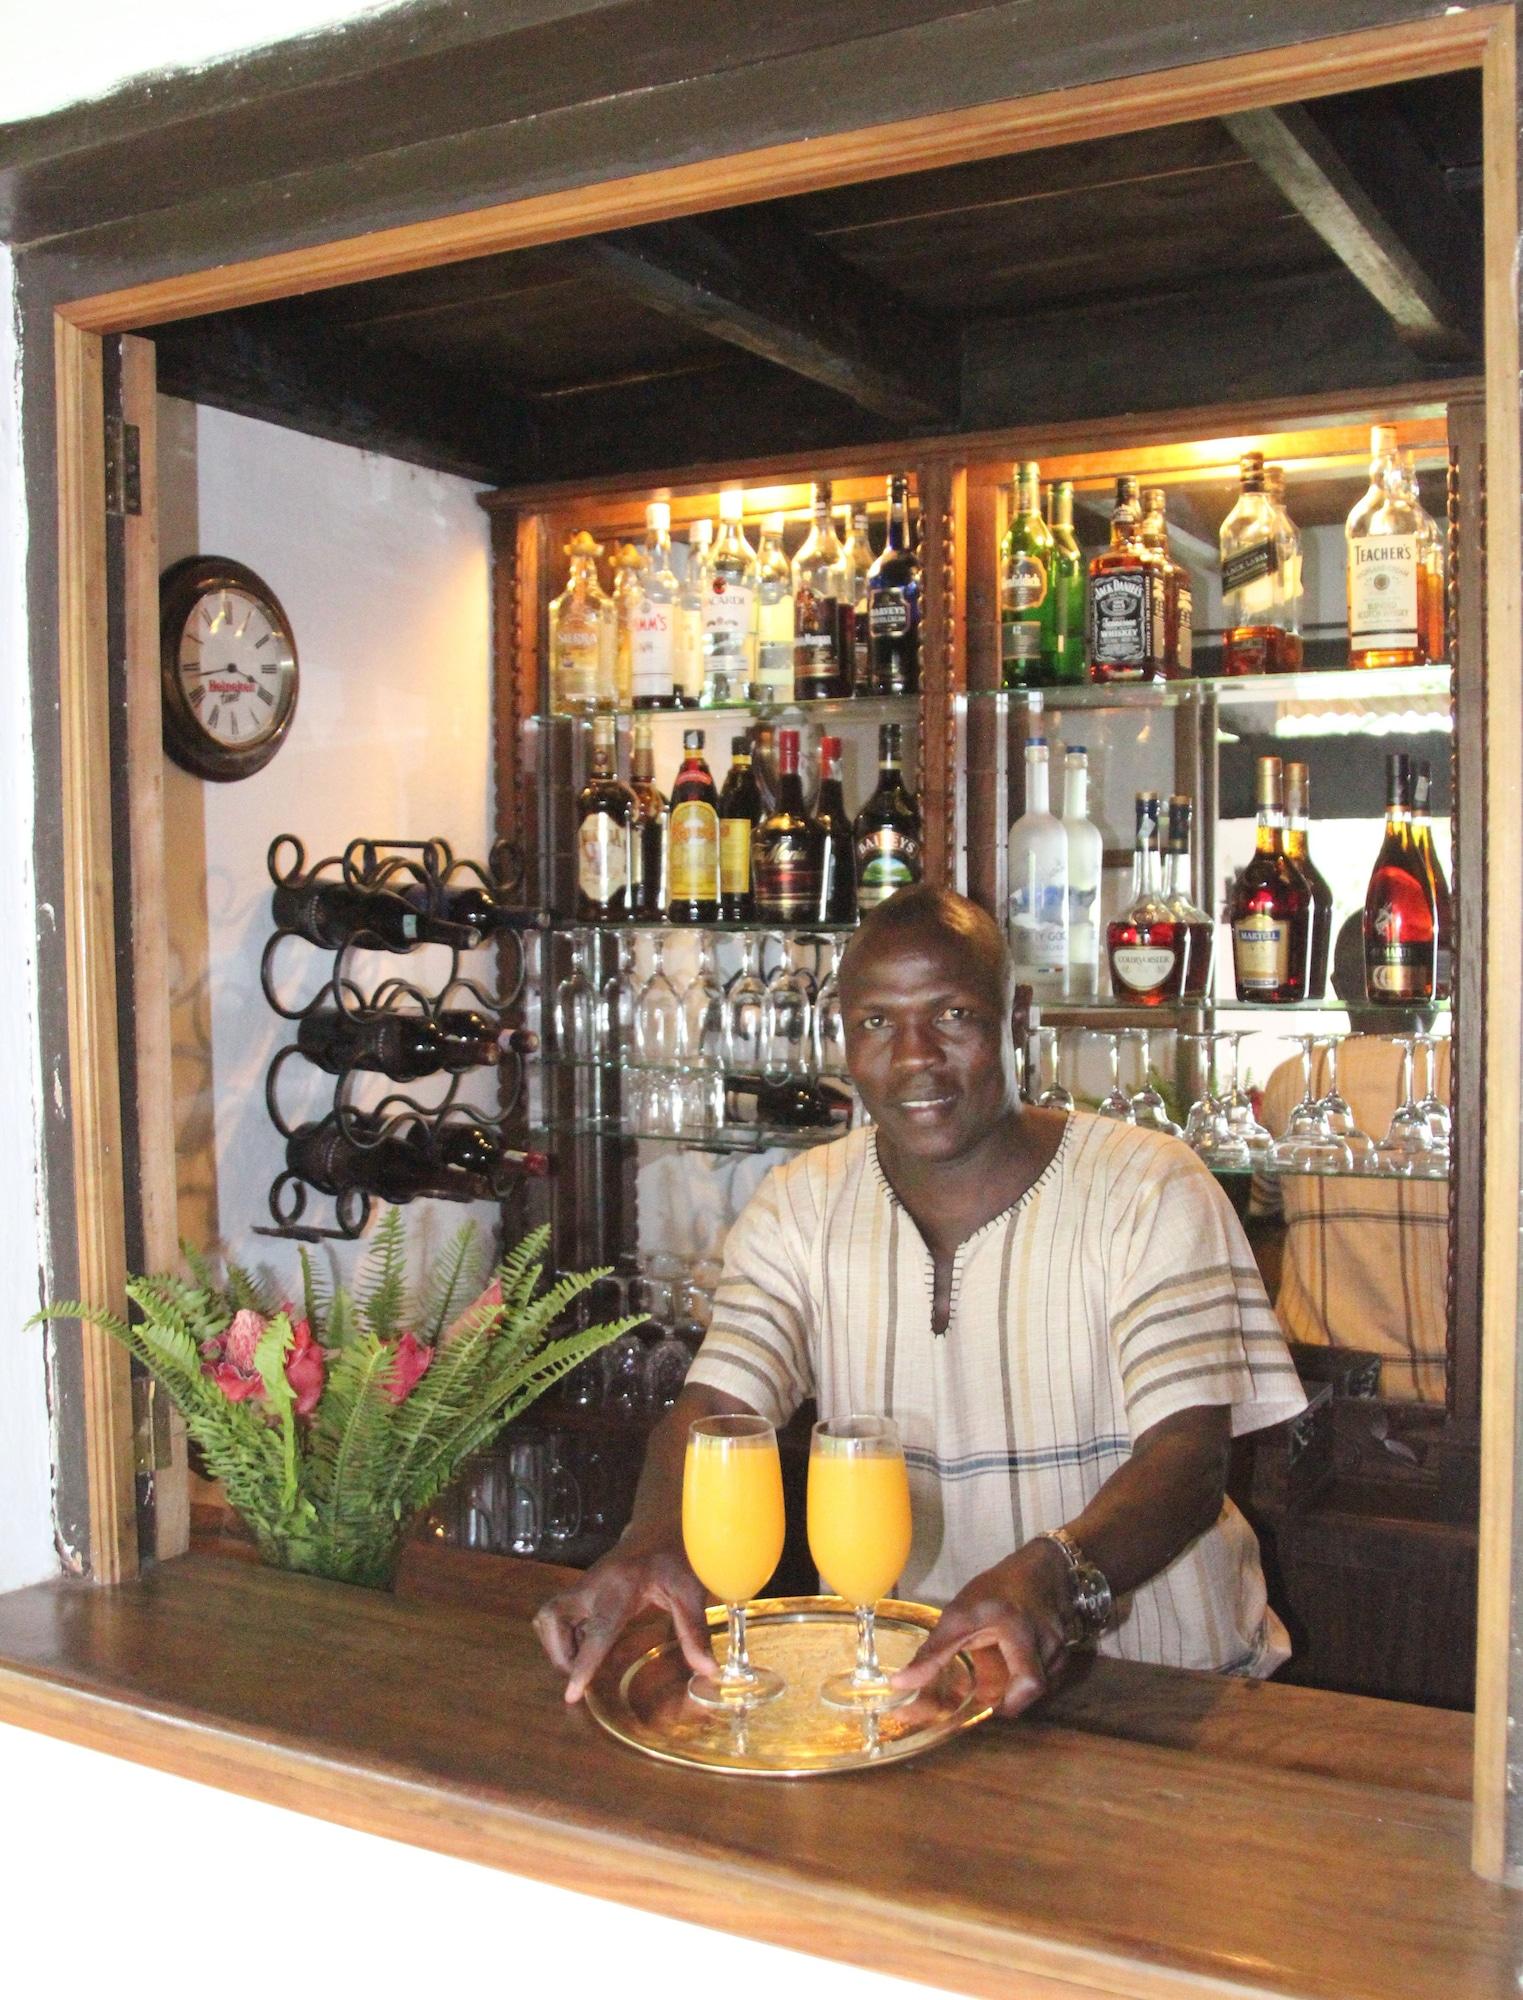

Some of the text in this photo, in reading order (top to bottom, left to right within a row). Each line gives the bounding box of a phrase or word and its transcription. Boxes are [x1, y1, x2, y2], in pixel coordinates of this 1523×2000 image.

[1355, 544, 1412, 565] TEACHER'S
[1095, 582, 1114, 600] JACK
[1100, 629, 1138, 639] WHISKEY
[208, 679, 257, 692] Heineken
[858, 834, 915, 854] BAIEYS
[1241, 931, 1278, 940] MARTELL
